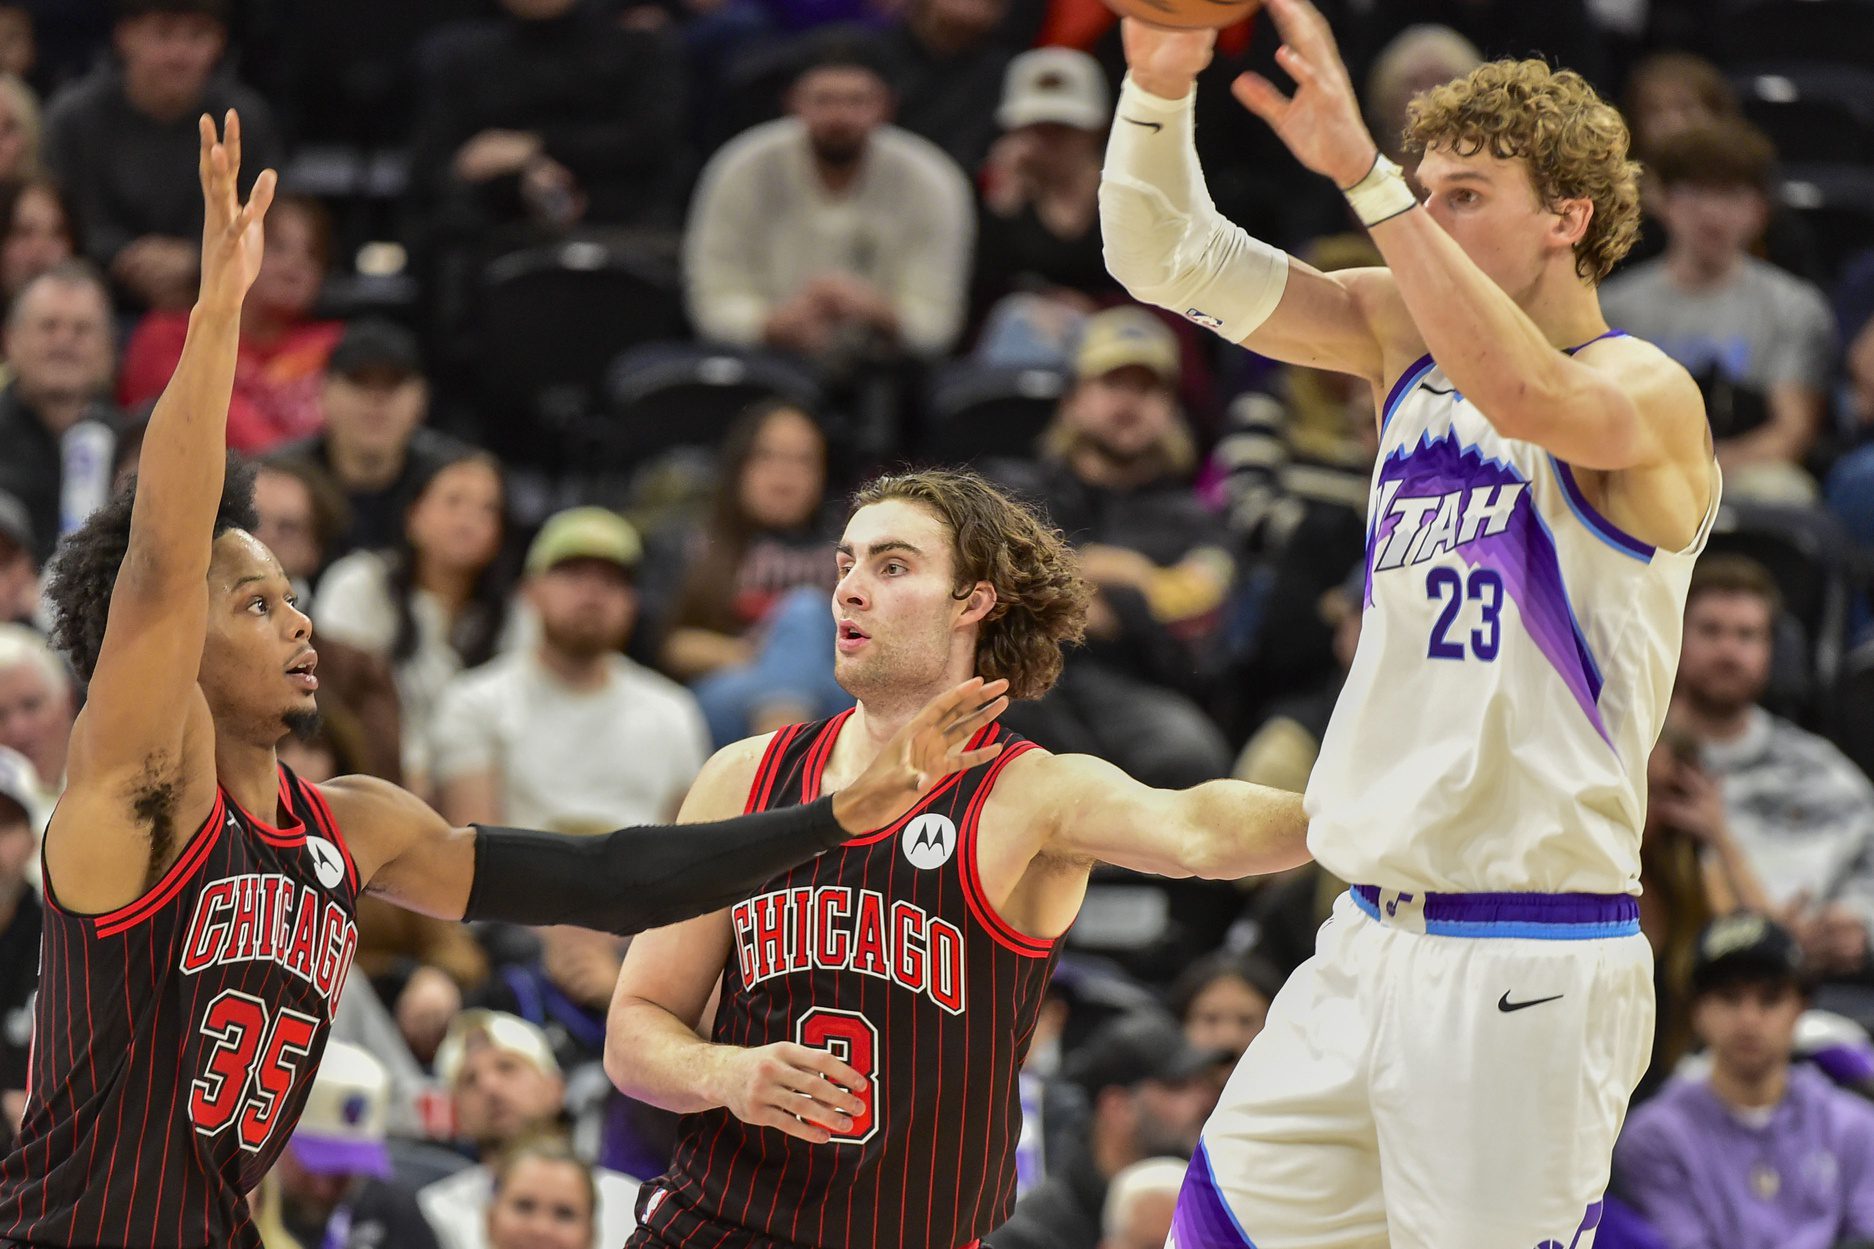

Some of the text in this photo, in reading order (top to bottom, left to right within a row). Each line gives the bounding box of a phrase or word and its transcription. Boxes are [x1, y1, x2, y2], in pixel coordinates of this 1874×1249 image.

[1426, 566, 1504, 663] 23
[179, 873, 359, 1026] CHICAGO
[731, 885, 966, 1017] CHICAGO
[187, 987, 321, 1153] 35
[796, 1005, 880, 1145] 3
